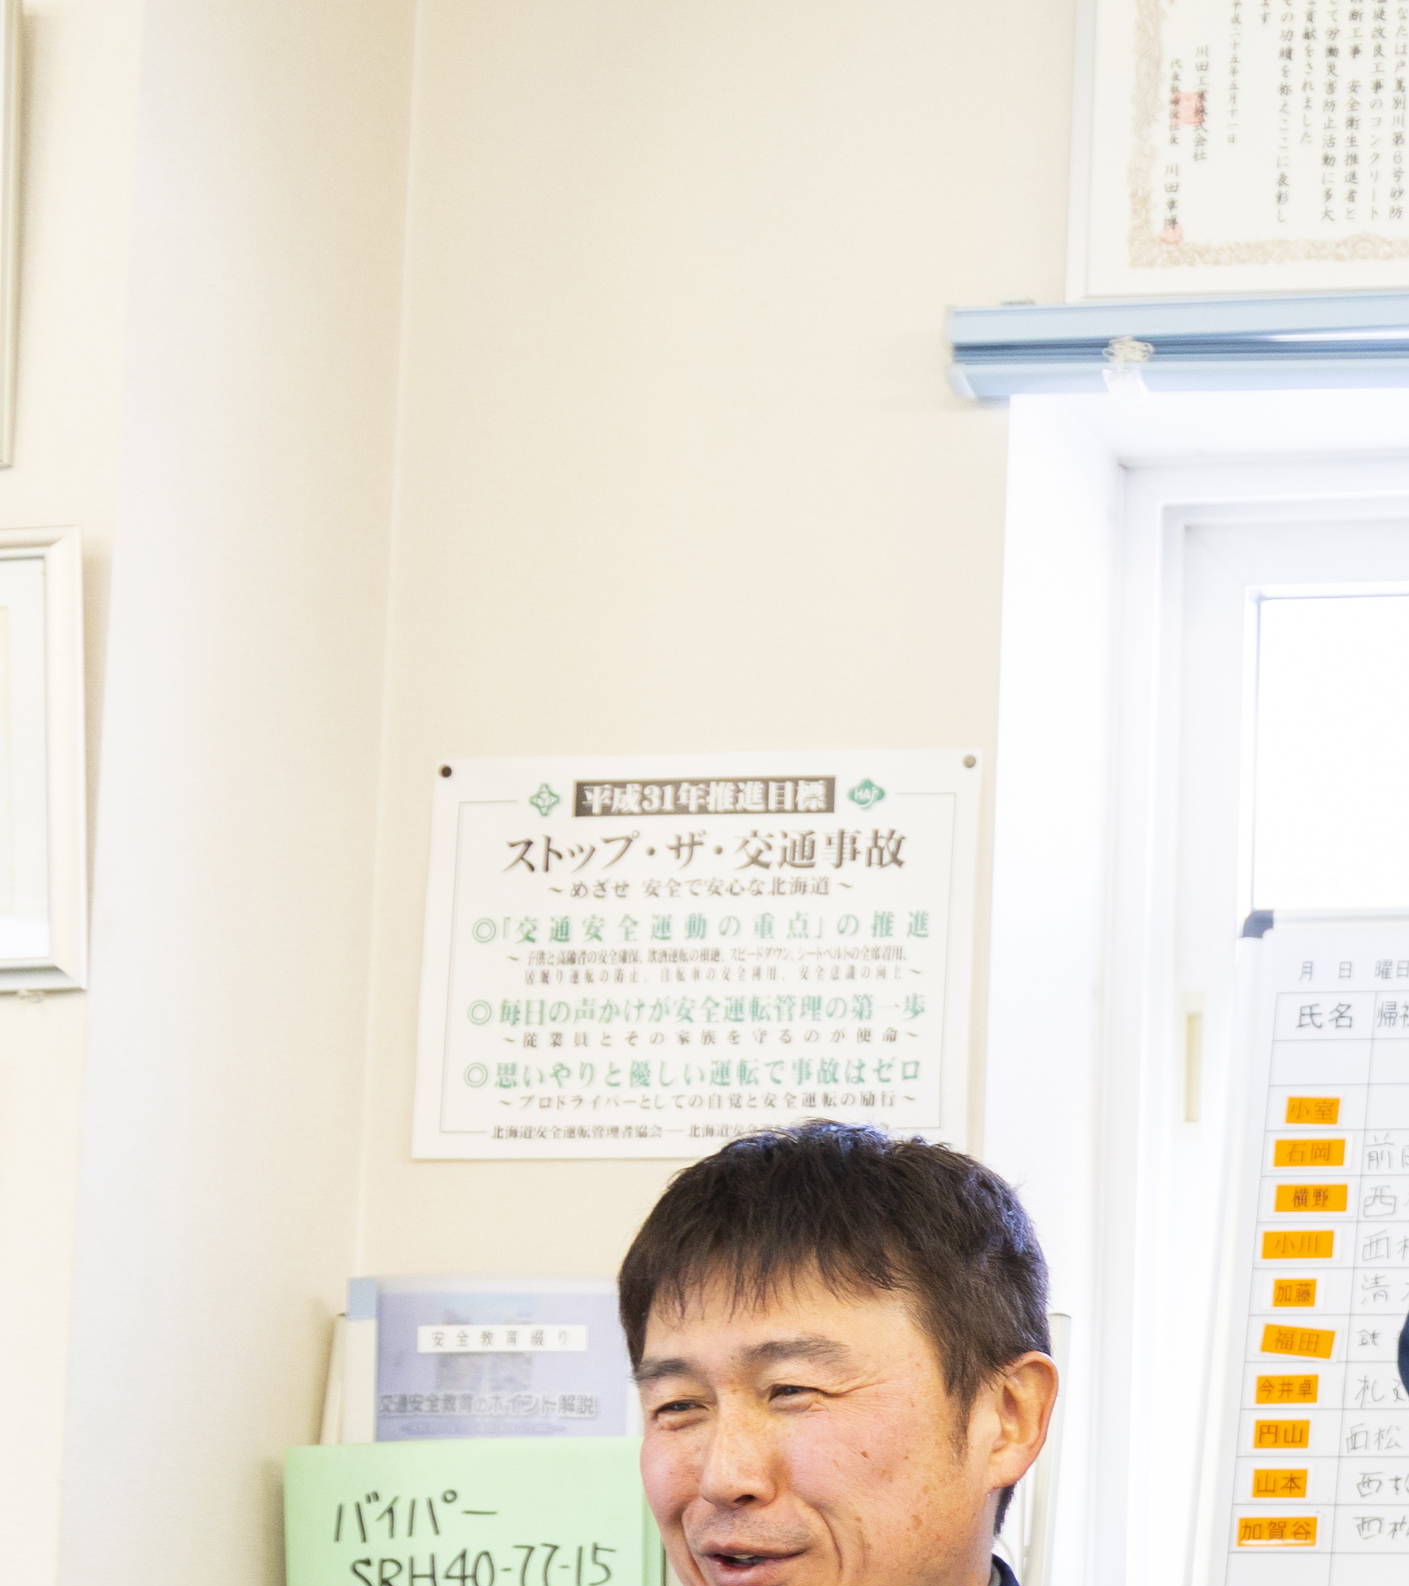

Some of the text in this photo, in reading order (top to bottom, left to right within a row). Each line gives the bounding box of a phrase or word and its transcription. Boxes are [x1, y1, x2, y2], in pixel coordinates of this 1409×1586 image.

[583, 779, 827, 813] 平成31年推進目標
[502, 829, 906, 873] ストップ・ザ・交通事故
[1299, 961, 1313, 981] 月
[1339, 961, 1352, 979] 日
[1296, 1003, 1353, 1028] 氏名
[1275, 1235, 1318, 1254] 小川
[1276, 1283, 1311, 1302] 加藤
[1273, 1329, 1319, 1353] 福田
[1258, 1424, 1303, 1444] 円山
[1257, 1473, 1301, 1493] 山本
[333, 1489, 498, 1543] バイパー
[1241, 1521, 1311, 1541] 加賀谷
